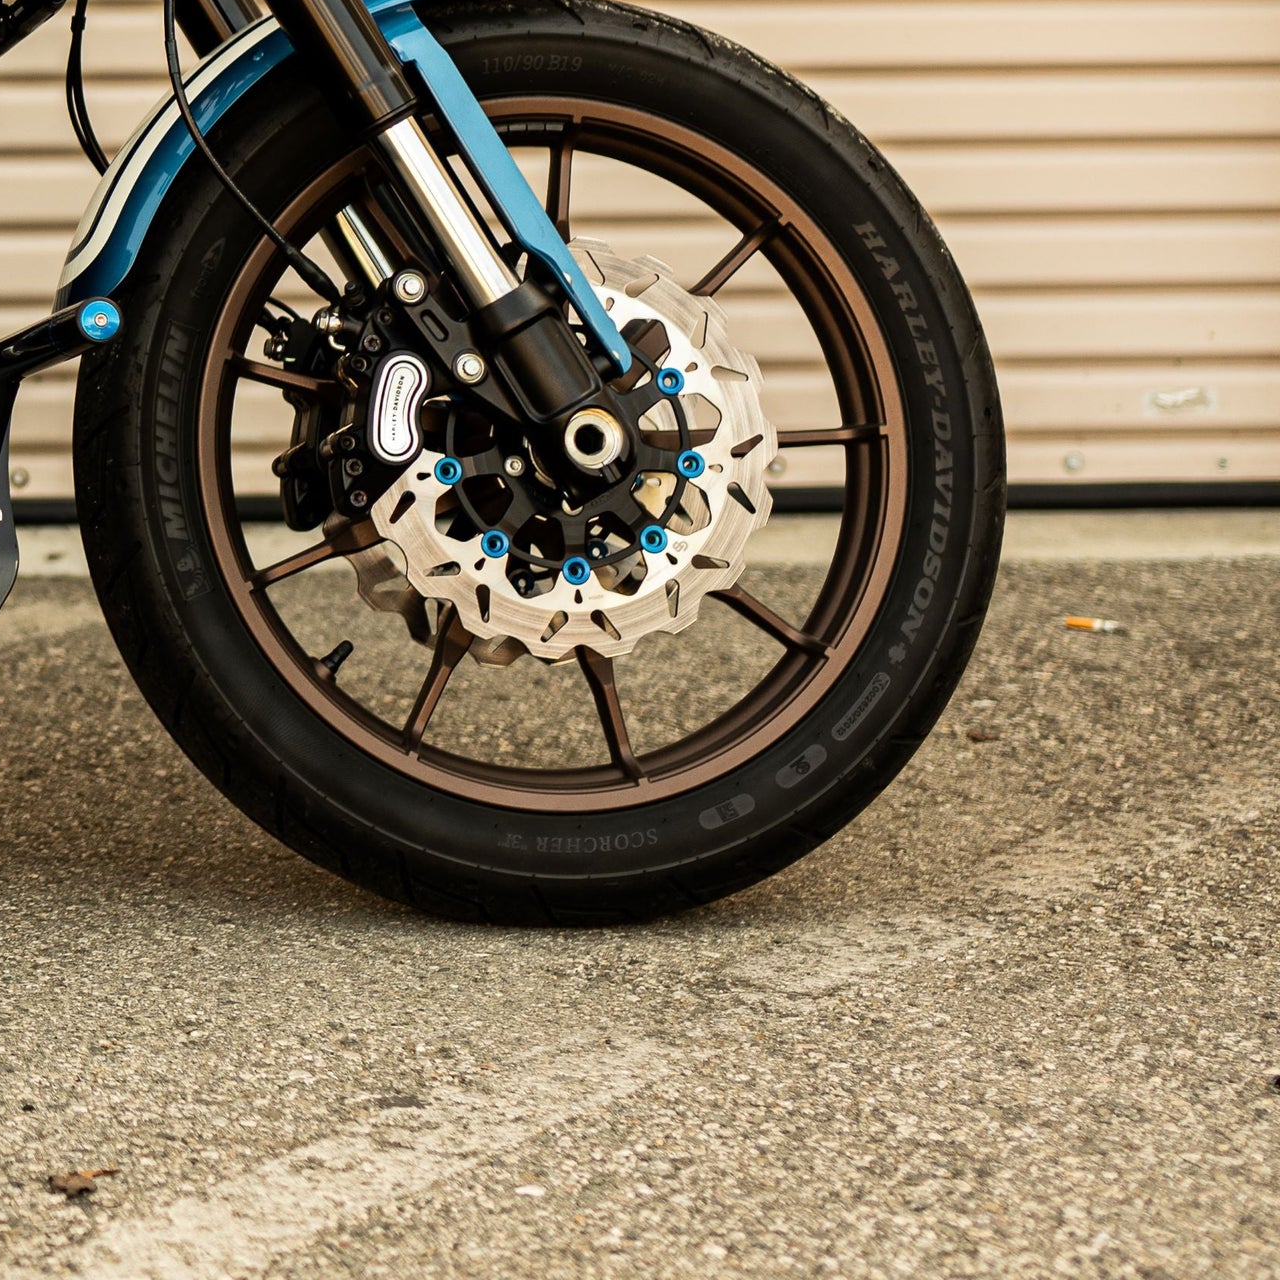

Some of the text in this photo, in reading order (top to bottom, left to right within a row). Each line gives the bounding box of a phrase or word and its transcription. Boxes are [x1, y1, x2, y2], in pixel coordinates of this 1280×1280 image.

[482, 53, 545, 76] 110/90
[160, 325, 191, 543] MICHELIN
[391, 375, 405, 441] HARLEY-DAVIDSON
[852, 218, 956, 638] HARLEY-DAVIDSON
[536, 824, 660, 857] SCORCHER
